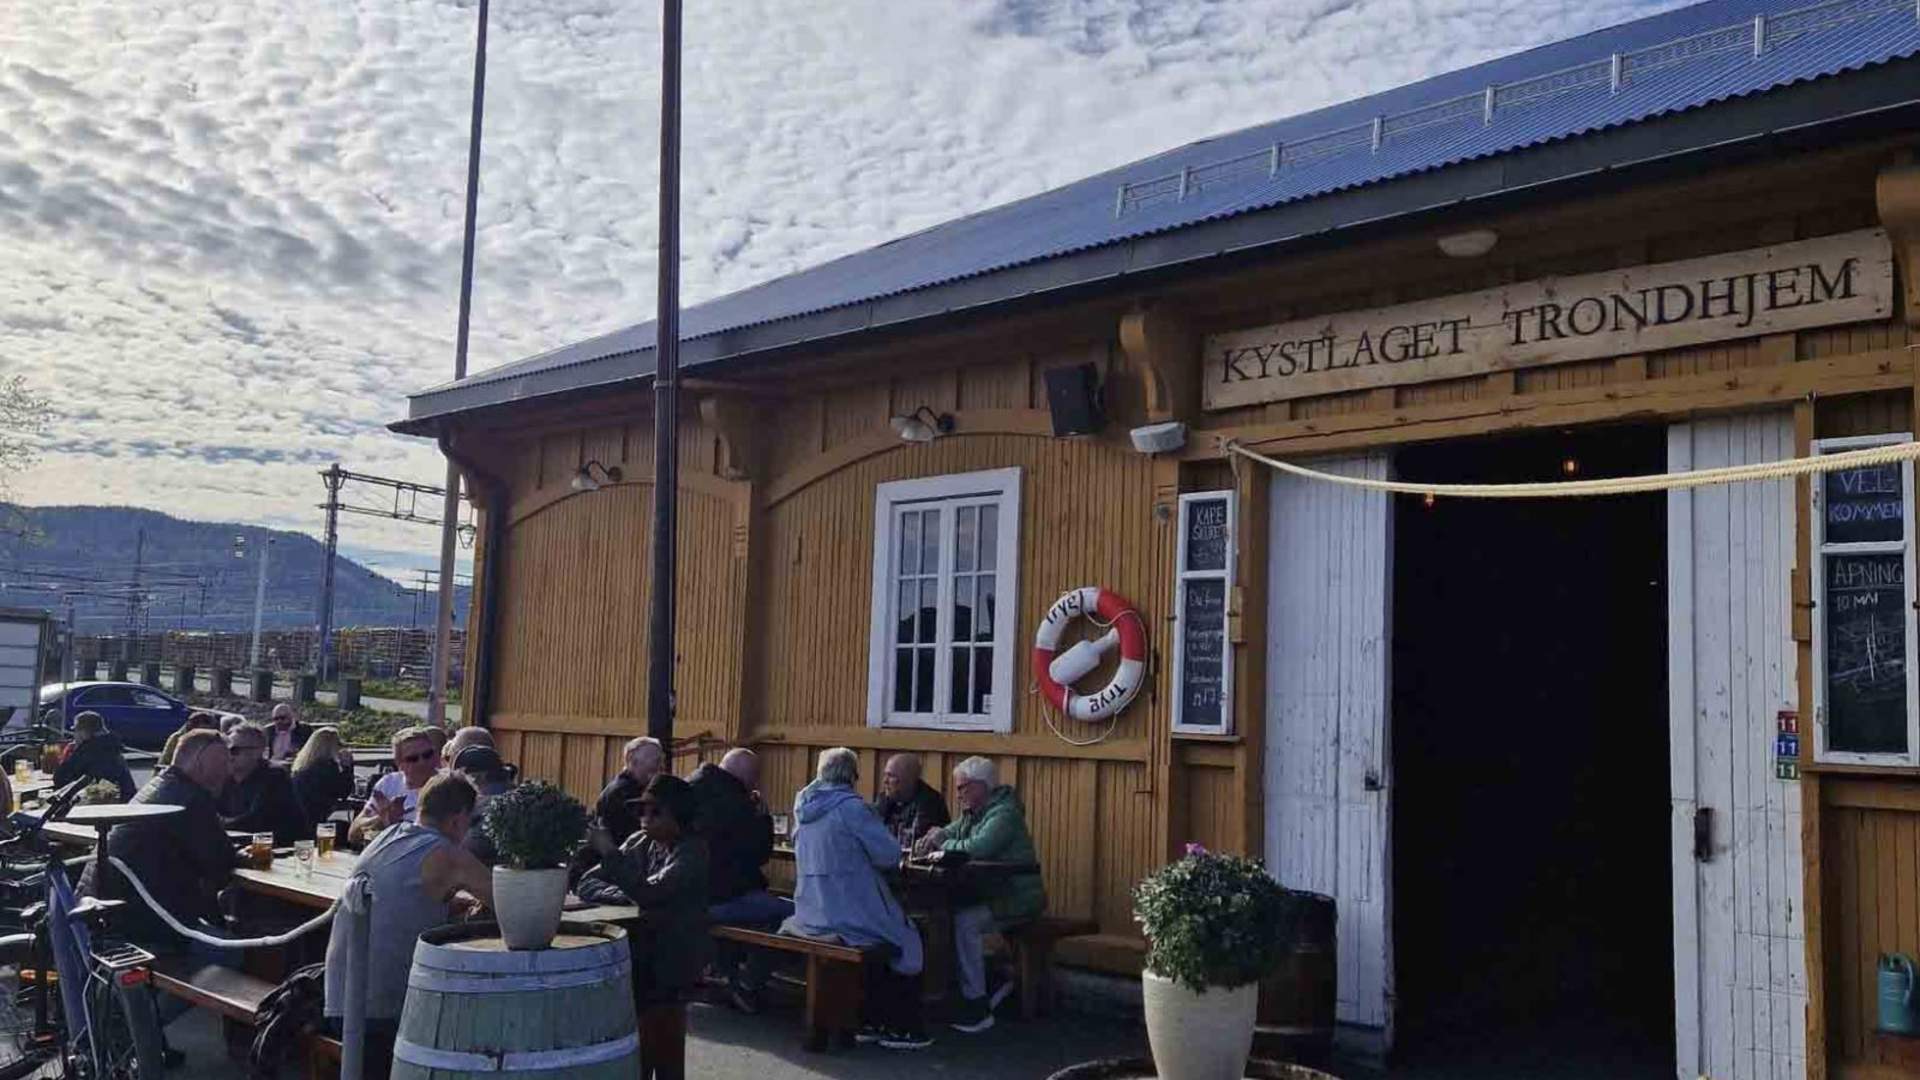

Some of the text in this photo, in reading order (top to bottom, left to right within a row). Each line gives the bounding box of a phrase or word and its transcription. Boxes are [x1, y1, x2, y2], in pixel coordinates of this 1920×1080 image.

[1221, 257, 1861, 383] KYSTLAGET TRONDHJEM
[1829, 501, 1903, 522] KOMMEN
[1853, 592, 1879, 607] MAI
[1088, 683, 1129, 713] Tryg
[1780, 718, 1797, 734] 11
[1778, 741, 1797, 755] 11
[1779, 763, 1801, 779] 11
